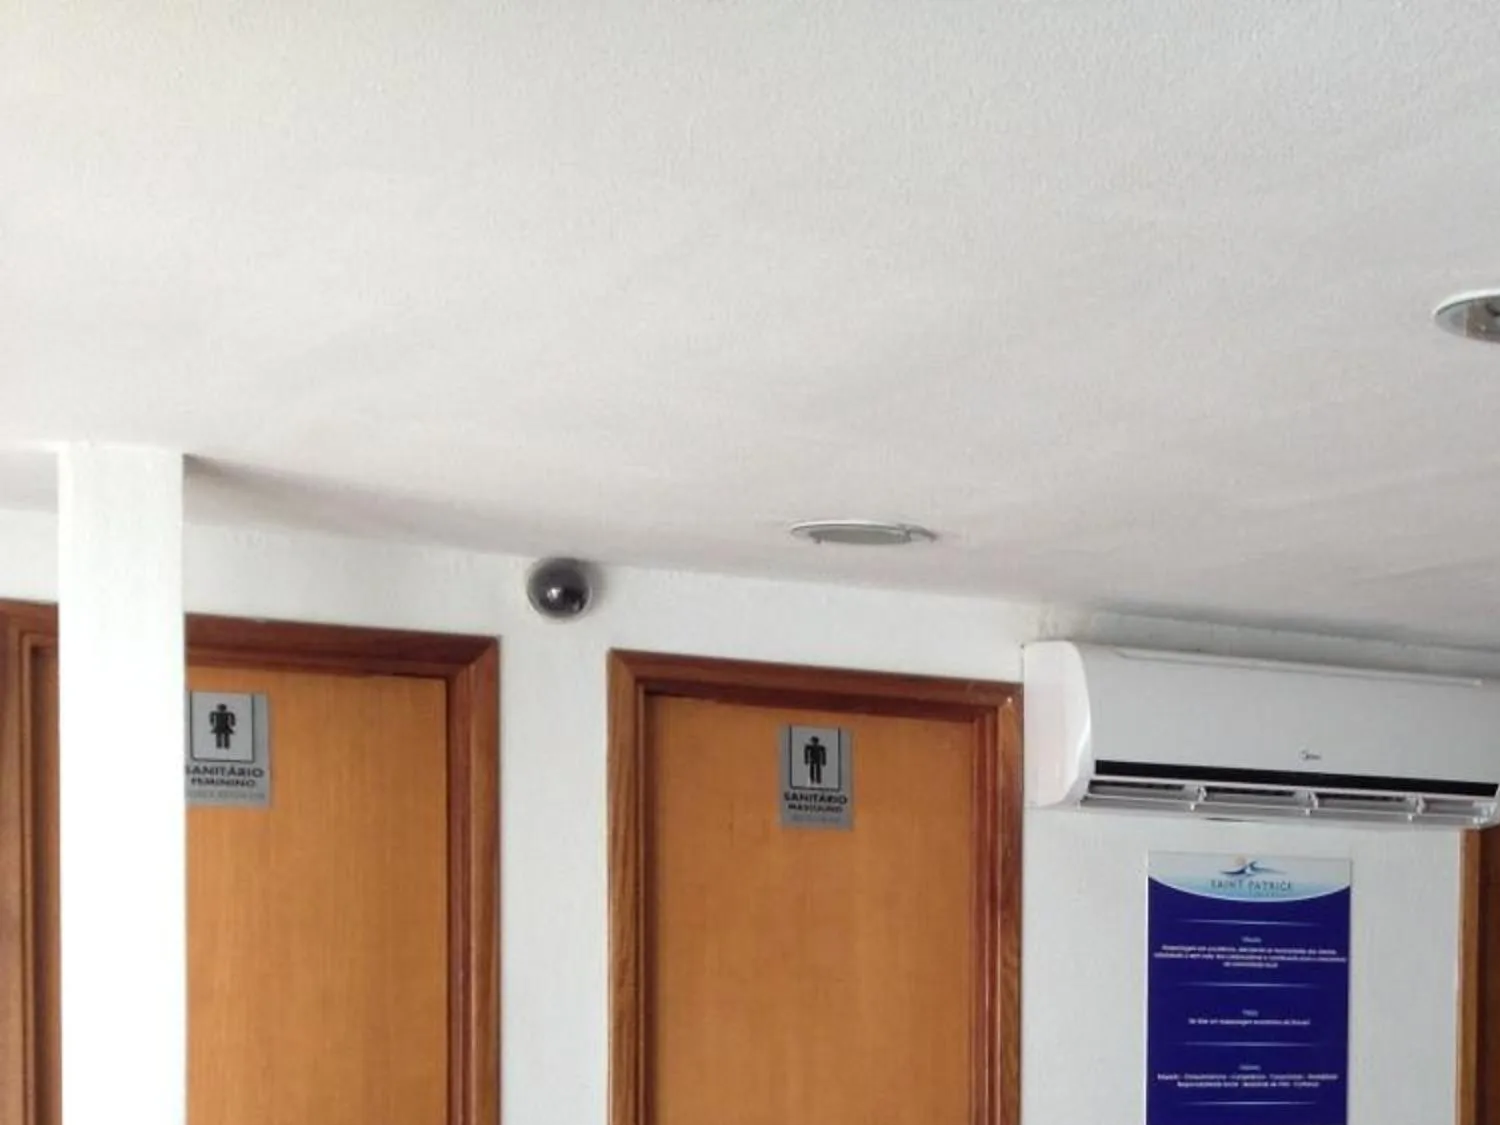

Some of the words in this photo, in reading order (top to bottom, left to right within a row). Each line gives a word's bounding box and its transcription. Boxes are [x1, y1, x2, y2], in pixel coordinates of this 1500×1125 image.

[185, 764, 265, 778] SANITÁRIO
[191, 777, 257, 788] FEMININO
[784, 790, 848, 804] SANITÁRIO
[1210, 879, 1243, 889] SAINT
